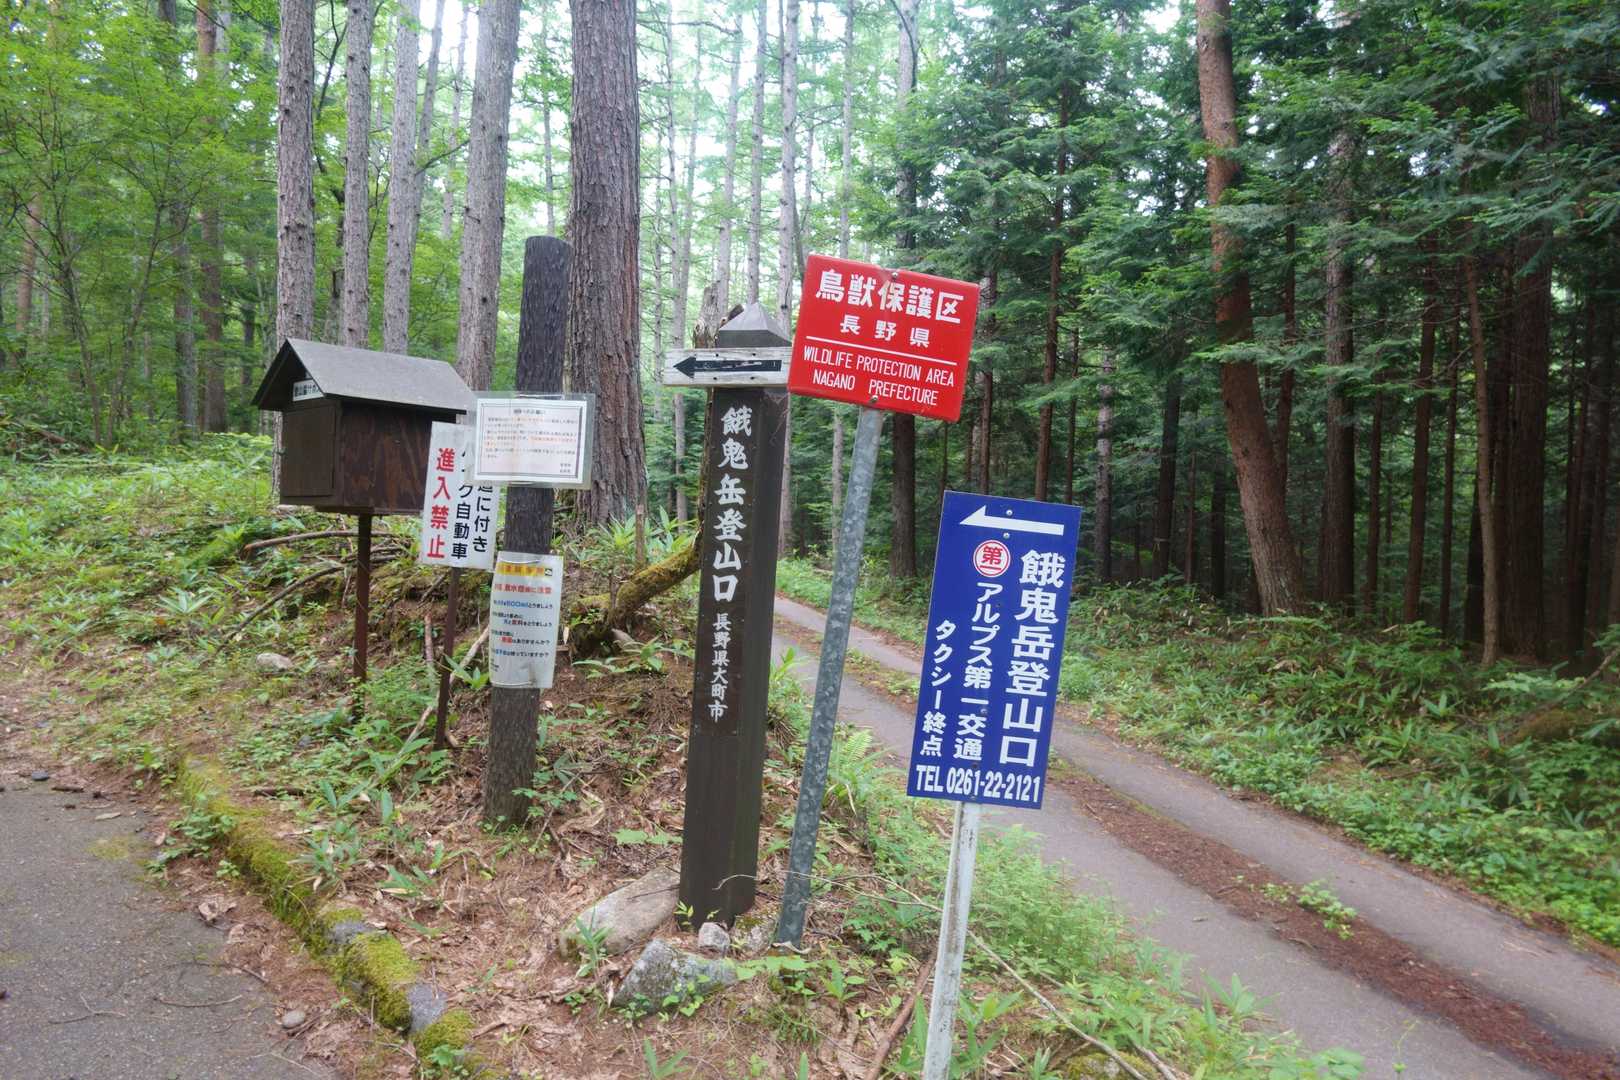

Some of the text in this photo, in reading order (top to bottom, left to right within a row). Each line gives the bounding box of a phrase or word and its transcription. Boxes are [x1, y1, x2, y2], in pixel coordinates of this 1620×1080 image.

[816, 269, 964, 324] 鳥獣保護区
[840, 314, 930, 348] 長野県
[803, 345, 954, 387] WILDLIFE PROTECTION AREA
[812, 369, 939, 406] NAGANO PREFECTURE
[426, 447, 456, 559] 進入禁止
[712, 405, 753, 603] 餓鬼岳登山口
[707, 612, 732, 723] 長野県大町市
[920, 619, 957, 758] タクシー終点
[953, 582, 1003, 762] アルプス第一交通
[999, 549, 1066, 767] 餓鬼岳登山口
[915, 764, 1041, 803] TEL 0261-22-2121
